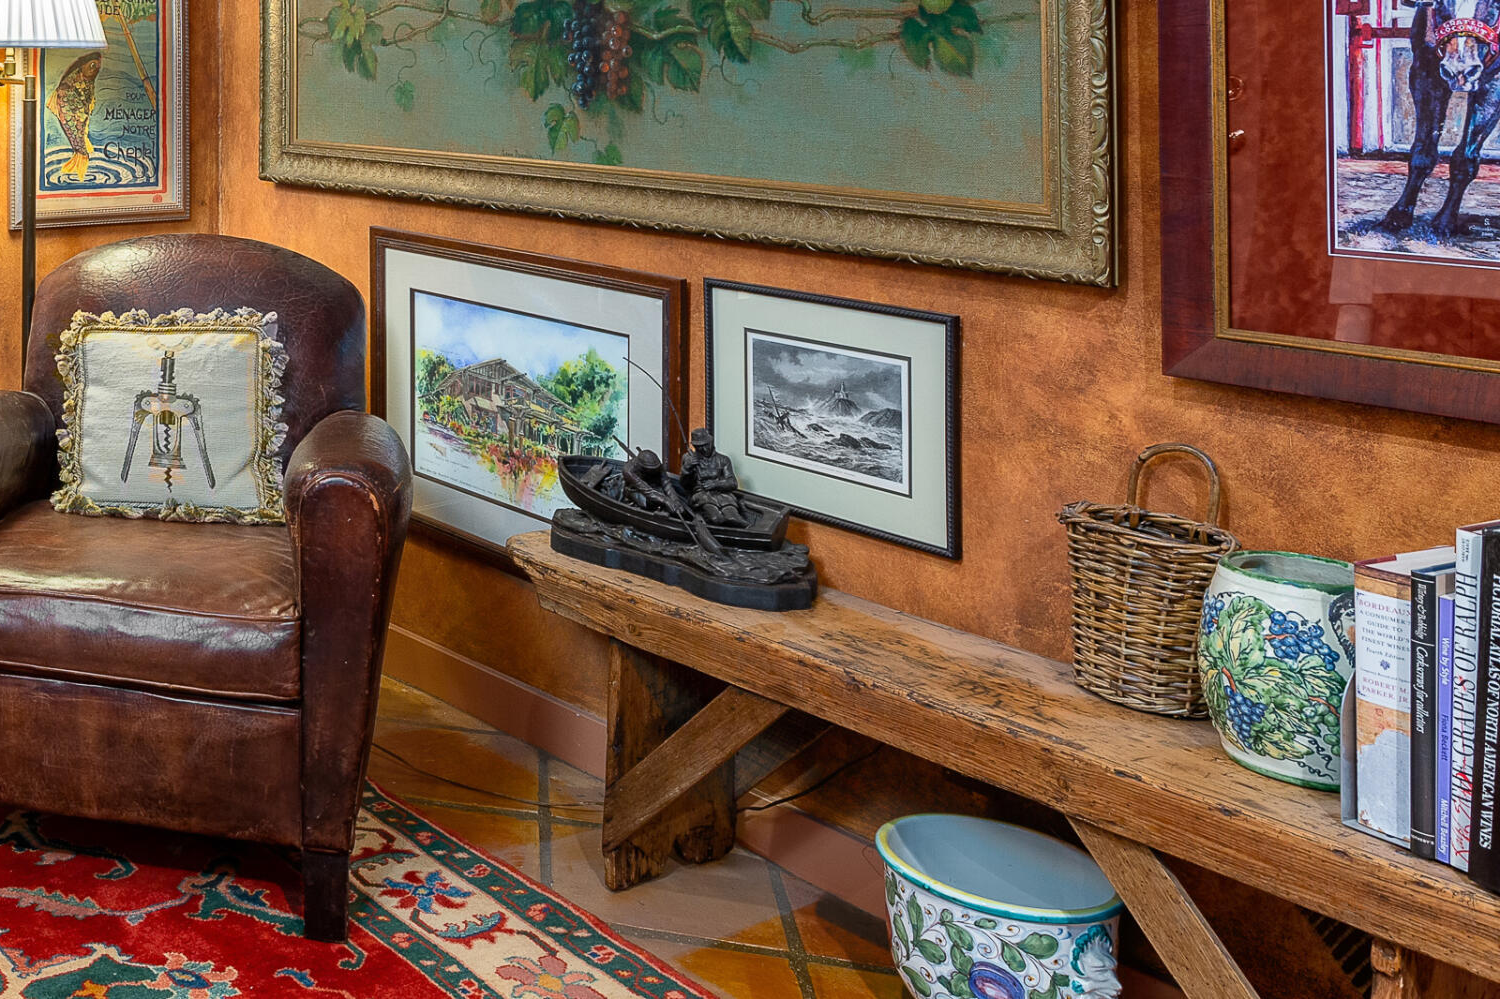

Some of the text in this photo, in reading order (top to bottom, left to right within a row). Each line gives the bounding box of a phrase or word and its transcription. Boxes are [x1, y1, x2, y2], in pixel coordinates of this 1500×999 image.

[104, 104, 157, 123] MÉNAGER
[116, 124, 156, 140] NOTRE
[1454, 570, 1478, 642] RALPH
[1361, 636, 1385, 647] FINEST
[1362, 627, 1374, 636] THE
[1366, 620, 1403, 633] GUIDE TO
[1439, 637, 1451, 687] Wine by Style
[1454, 641, 1477, 673] OF
[1487, 642, 1500, 681] ATLAS
[1363, 676, 1397, 692] ROBERT
[1413, 684, 1429, 701] for
[1485, 680, 1500, 700] OF
[1415, 699, 1430, 734] collectors
[1452, 674, 1476, 759] GRAPES
[1483, 700, 1500, 745] NORTH
[1440, 714, 1450, 762] Fiona Beckett
[1481, 743, 1498, 810] AMERICAN
[1439, 798, 1449, 829] Mitchell
[1479, 809, 1495, 850] WINES
